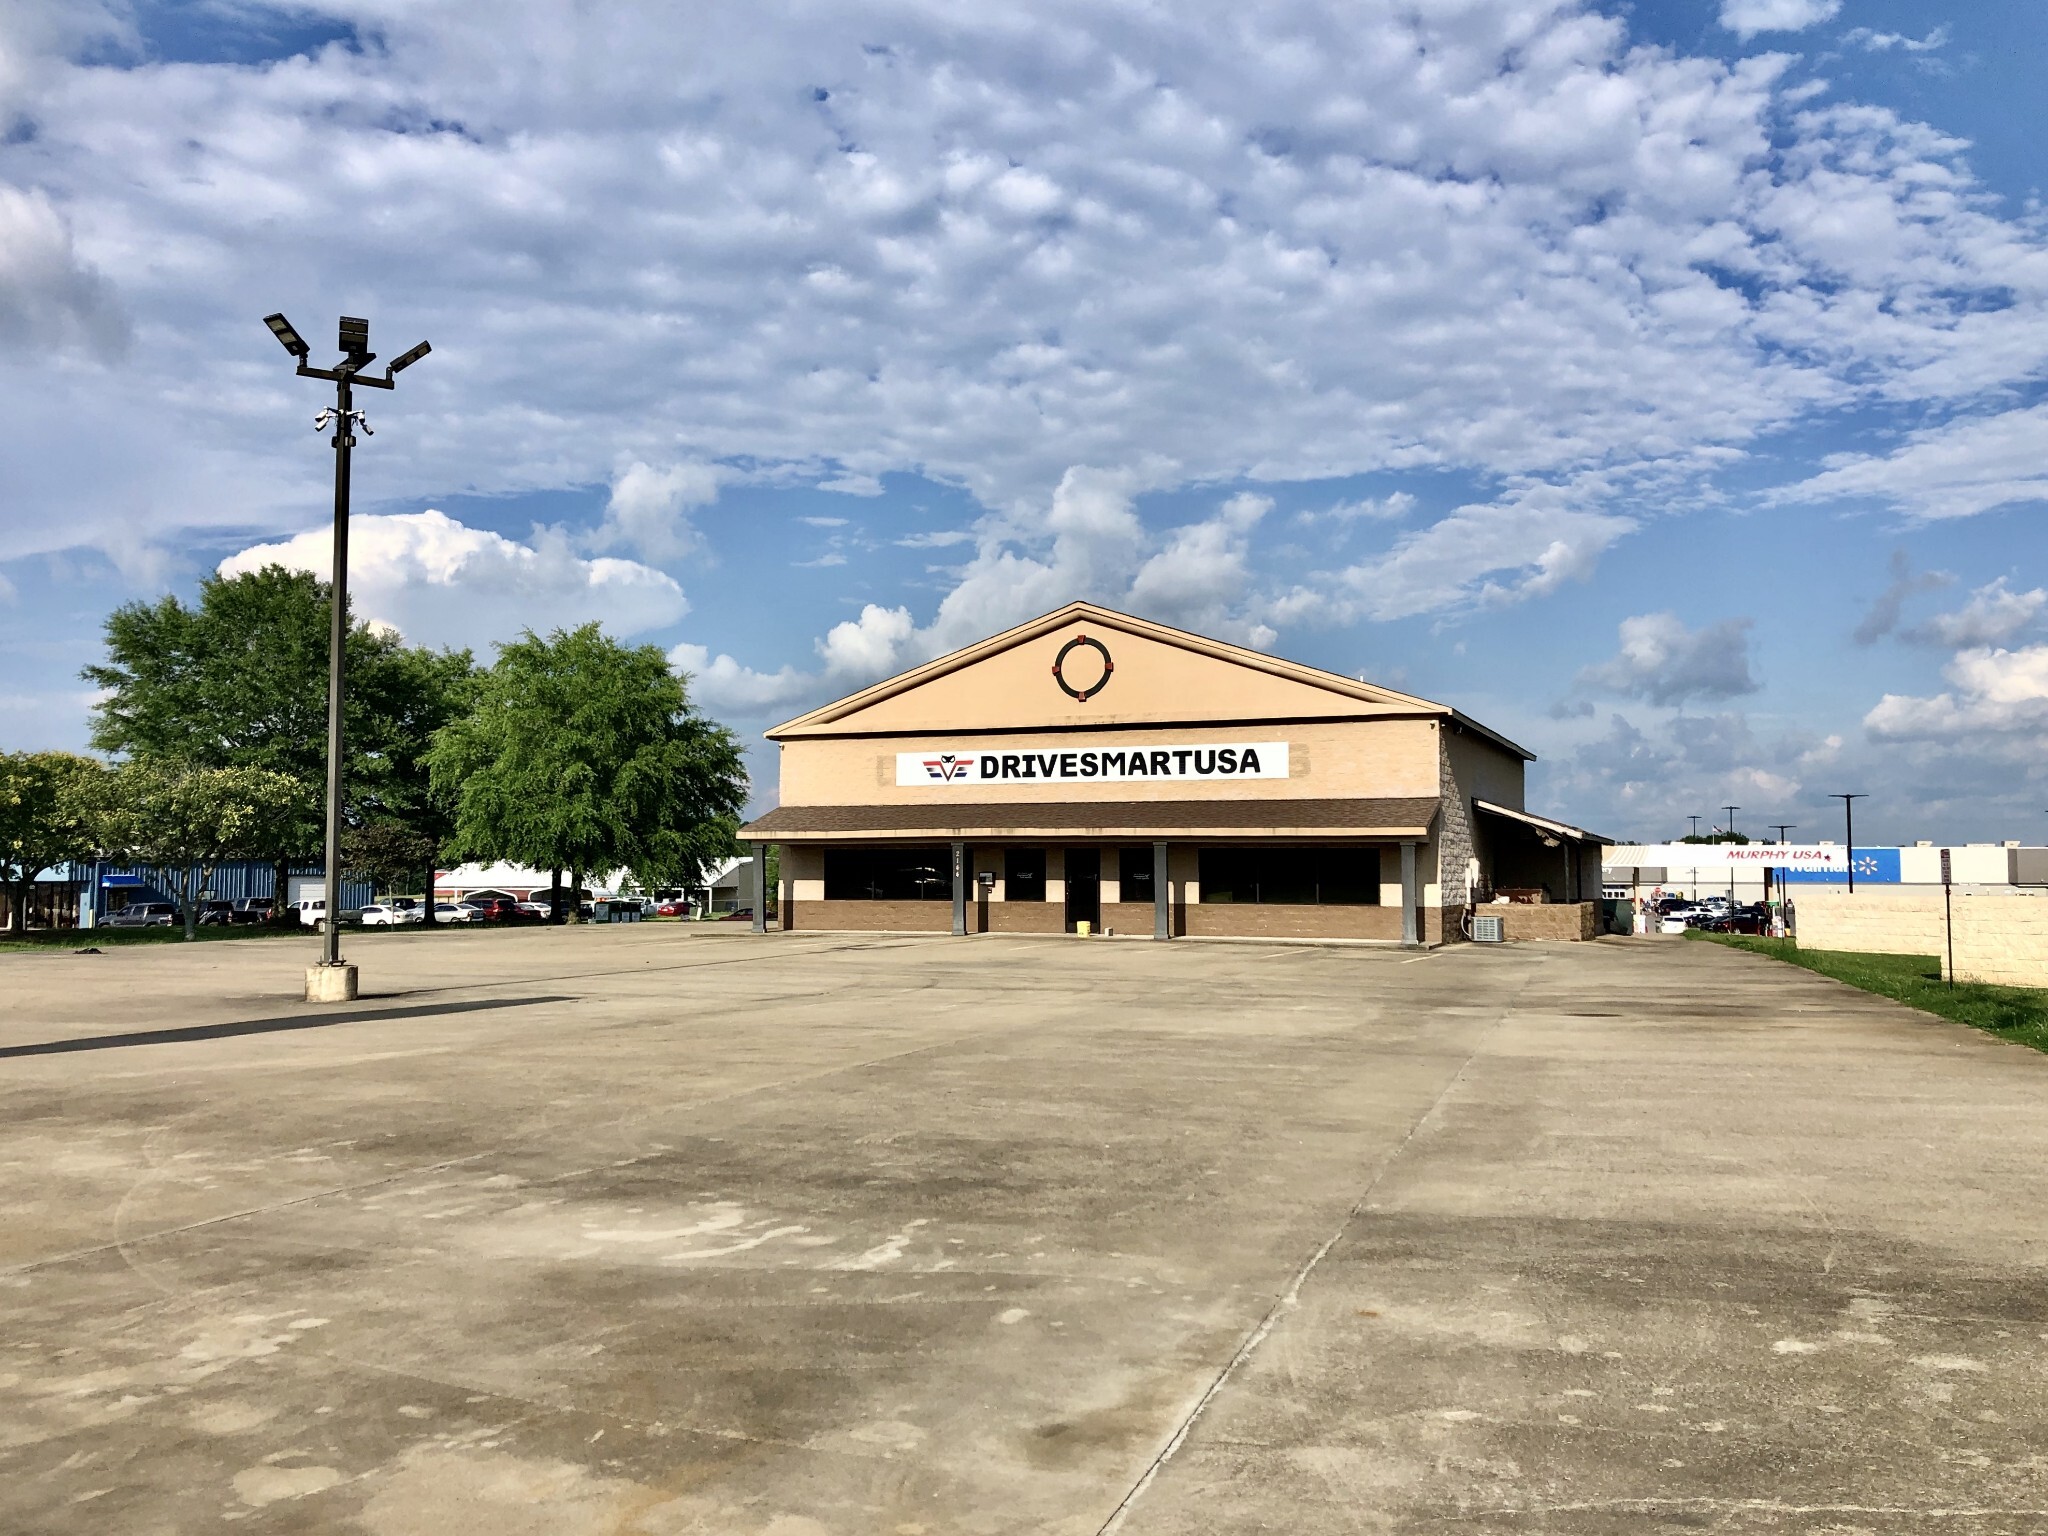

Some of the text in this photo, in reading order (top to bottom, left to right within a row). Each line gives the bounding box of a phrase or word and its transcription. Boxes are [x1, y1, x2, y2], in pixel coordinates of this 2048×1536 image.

[980, 748, 1261, 779] DRIVESMARTUSA
[1726, 850, 1822, 860] MURPHY USA
